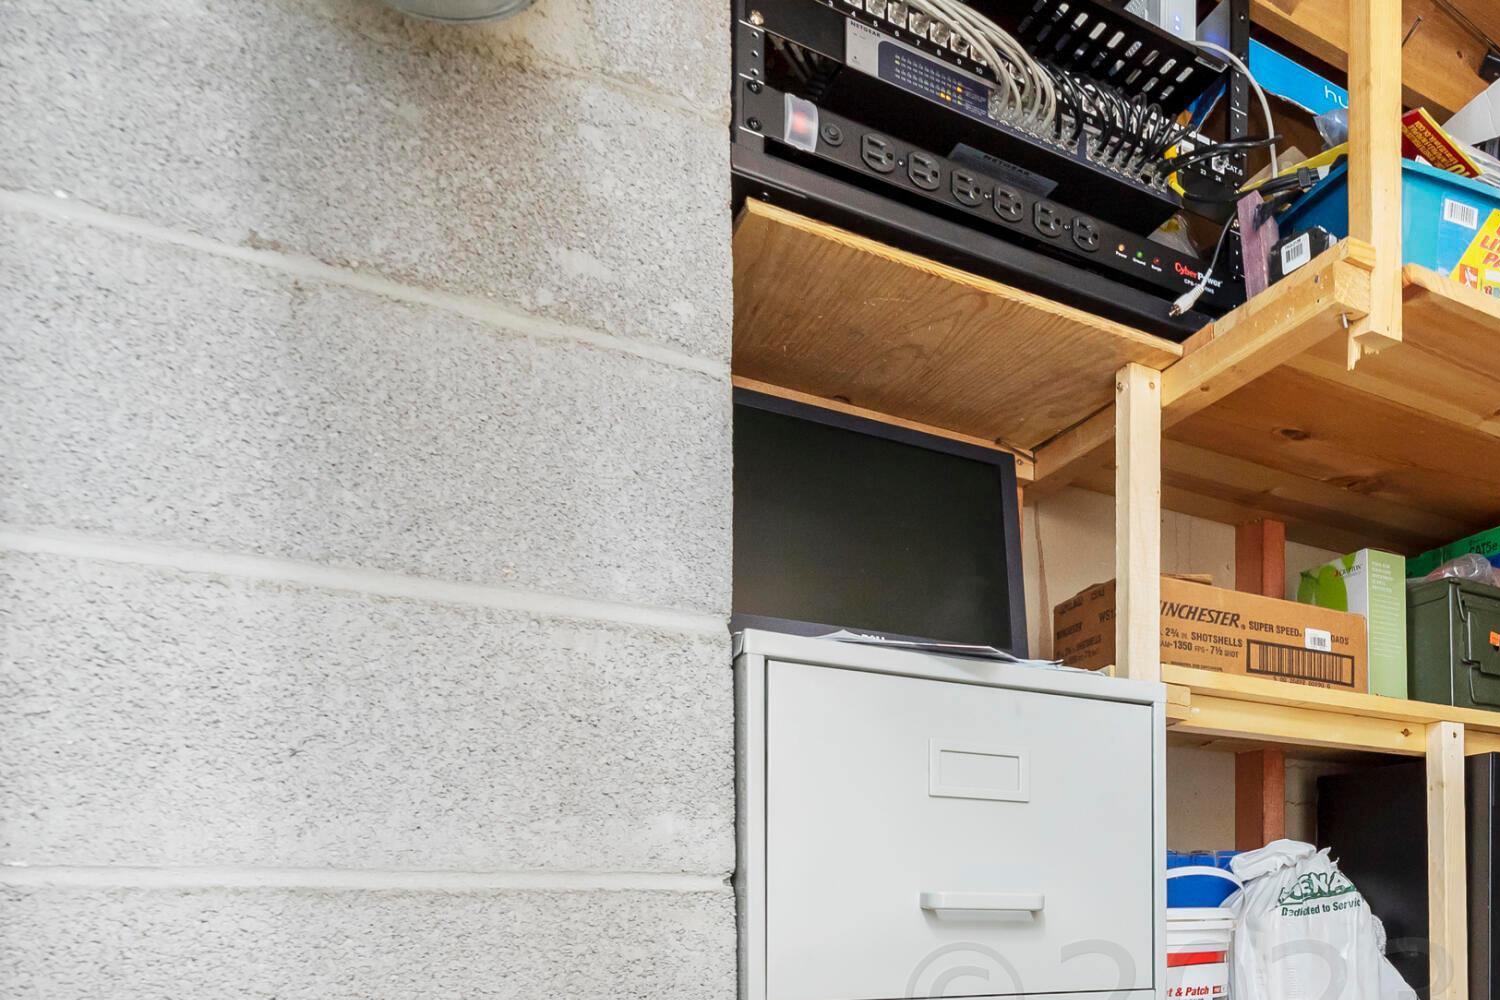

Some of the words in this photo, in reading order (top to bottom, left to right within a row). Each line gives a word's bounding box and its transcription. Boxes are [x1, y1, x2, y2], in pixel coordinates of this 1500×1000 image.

[849, 20, 881, 38] NETGEAR
[1174, 261, 1223, 287] CyberPwer
[1469, 540, 1498, 556] CAT5e
[1160, 600, 1241, 628] INCHESTER
[1248, 621, 1274, 633] SUPER
[1330, 634, 1350, 646] OADS
[1190, 631, 1243, 648] SHOTSHELLS
[1322, 903, 1331, 913] to
[1175, 986, 1184, 997] &
[1185, 985, 1209, 998] Patch
